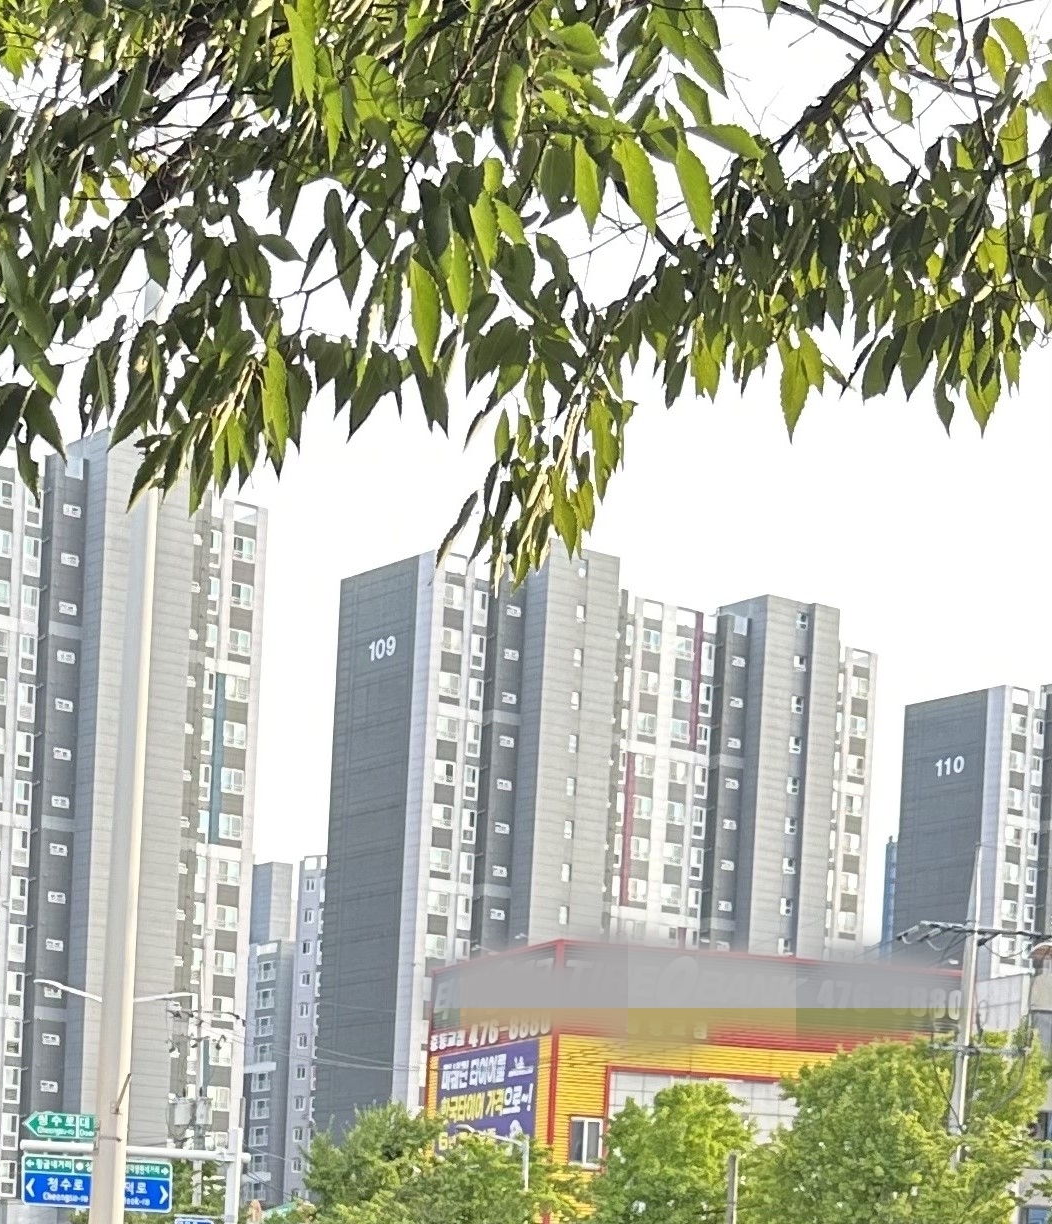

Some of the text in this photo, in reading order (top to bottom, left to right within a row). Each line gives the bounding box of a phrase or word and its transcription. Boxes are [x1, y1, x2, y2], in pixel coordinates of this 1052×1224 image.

[368, 635, 397, 662] 109
[935, 755, 965, 777] 110
[468, 1010, 551, 1048] 476-8880
[46, 1176, 85, 1192] 청수로
